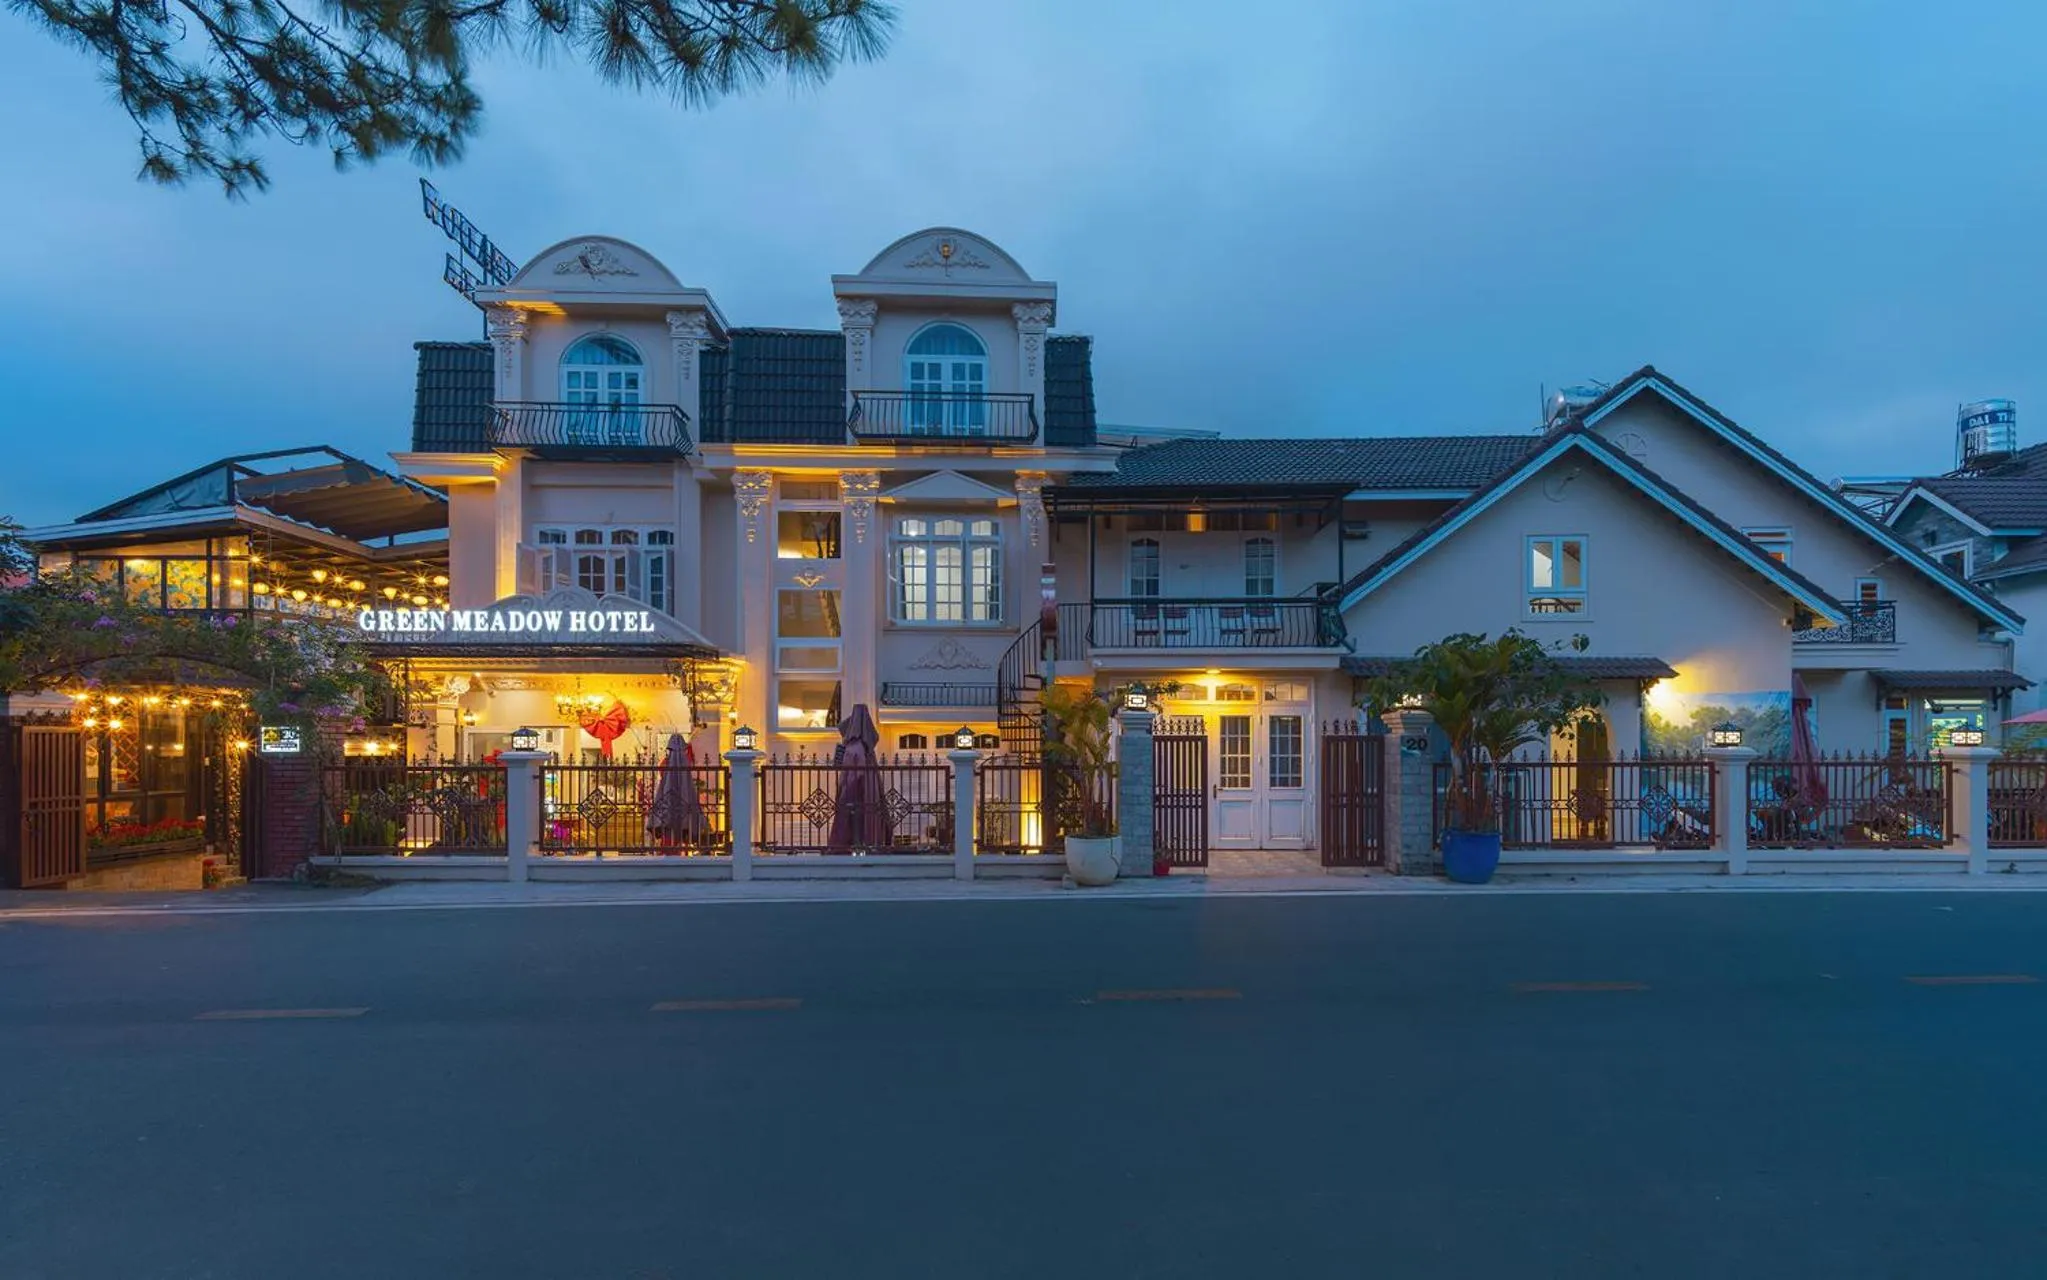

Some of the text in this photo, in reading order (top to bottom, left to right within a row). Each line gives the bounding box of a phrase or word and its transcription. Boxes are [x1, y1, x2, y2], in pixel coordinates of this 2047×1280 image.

[359, 610, 655, 632] GREEN MEADOW HOTEL
[1406, 738, 1428, 751] 20
